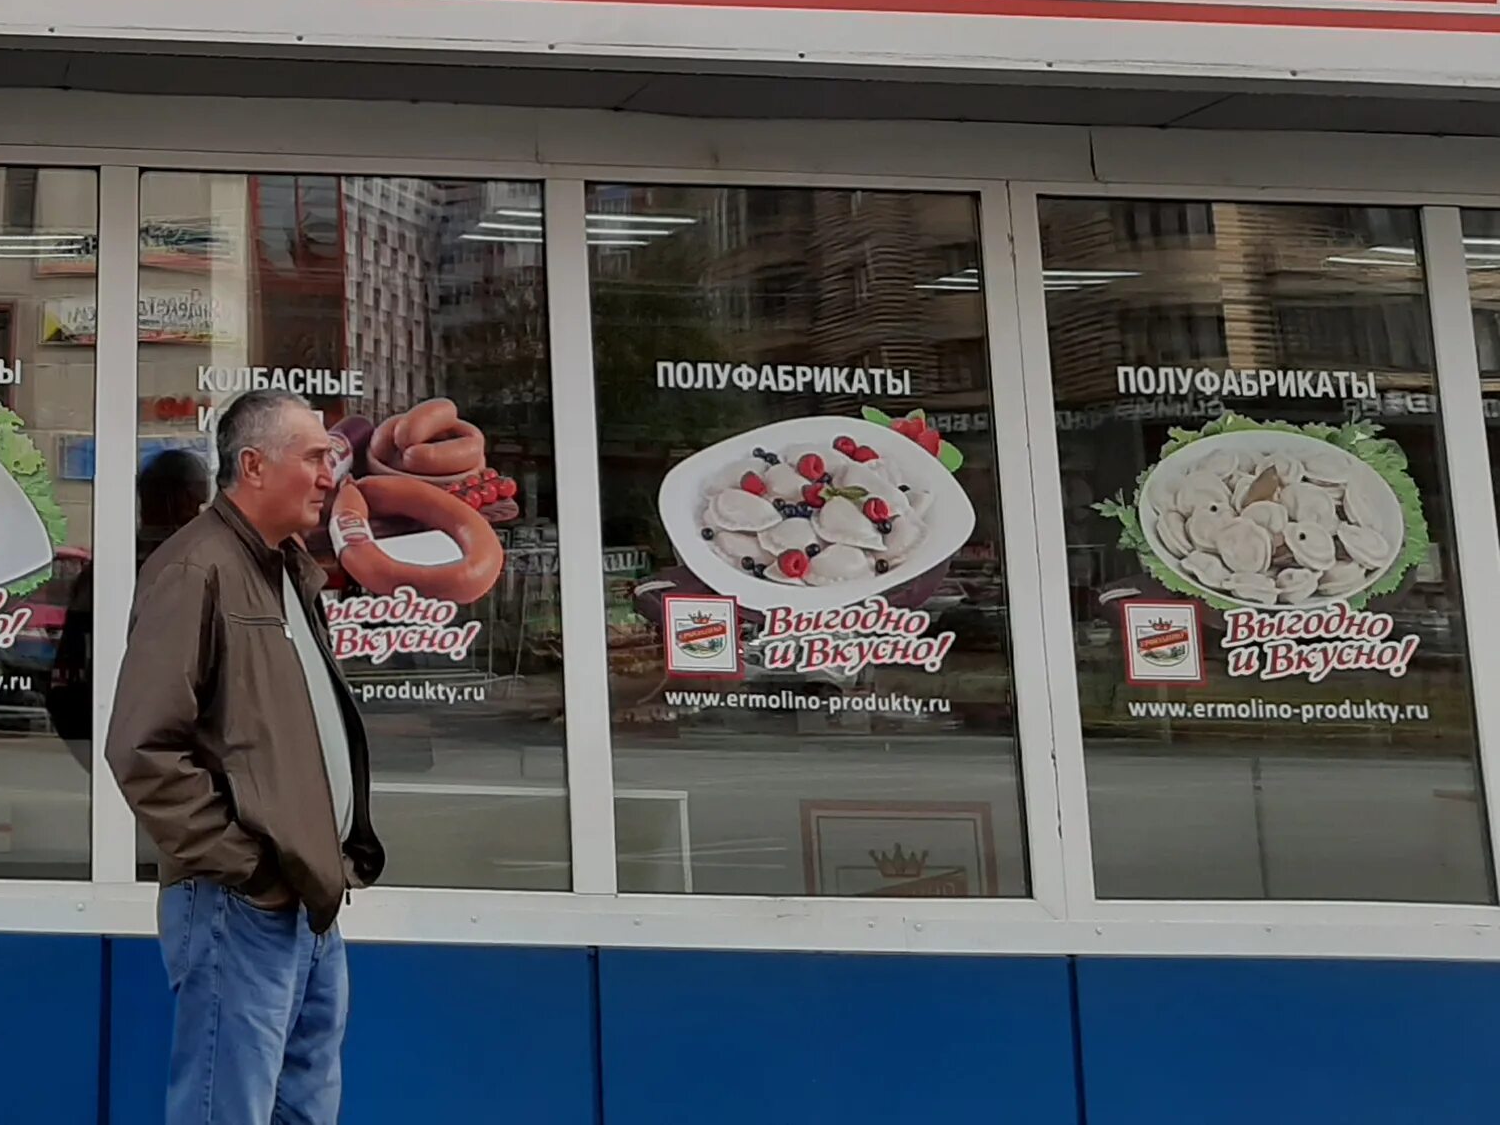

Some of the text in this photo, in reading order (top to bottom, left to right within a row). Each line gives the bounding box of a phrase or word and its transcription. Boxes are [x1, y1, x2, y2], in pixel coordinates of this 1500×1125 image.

[197, 365, 365, 397] КОЛБАСНЫЕ
[656, 361, 912, 396] ПОЛУФАБРИКАТЫ
[1117, 365, 1377, 400] ПОЛУФАБРИКАТЫ
[322, 587, 455, 626] ыгодно
[764, 598, 930, 639] Выгодно
[1223, 605, 1391, 644] Выгодно
[332, 623, 479, 662] Вкусно!
[766, 634, 954, 672] и Вкусно!
[1228, 639, 1419, 680] и Вкусно!
[349, 681, 485, 703] -produkty.ru
[665, 690, 951, 714] www.ermolino-produkty.ru
[1128, 699, 1429, 722] www.ermolino-produkty.ru
